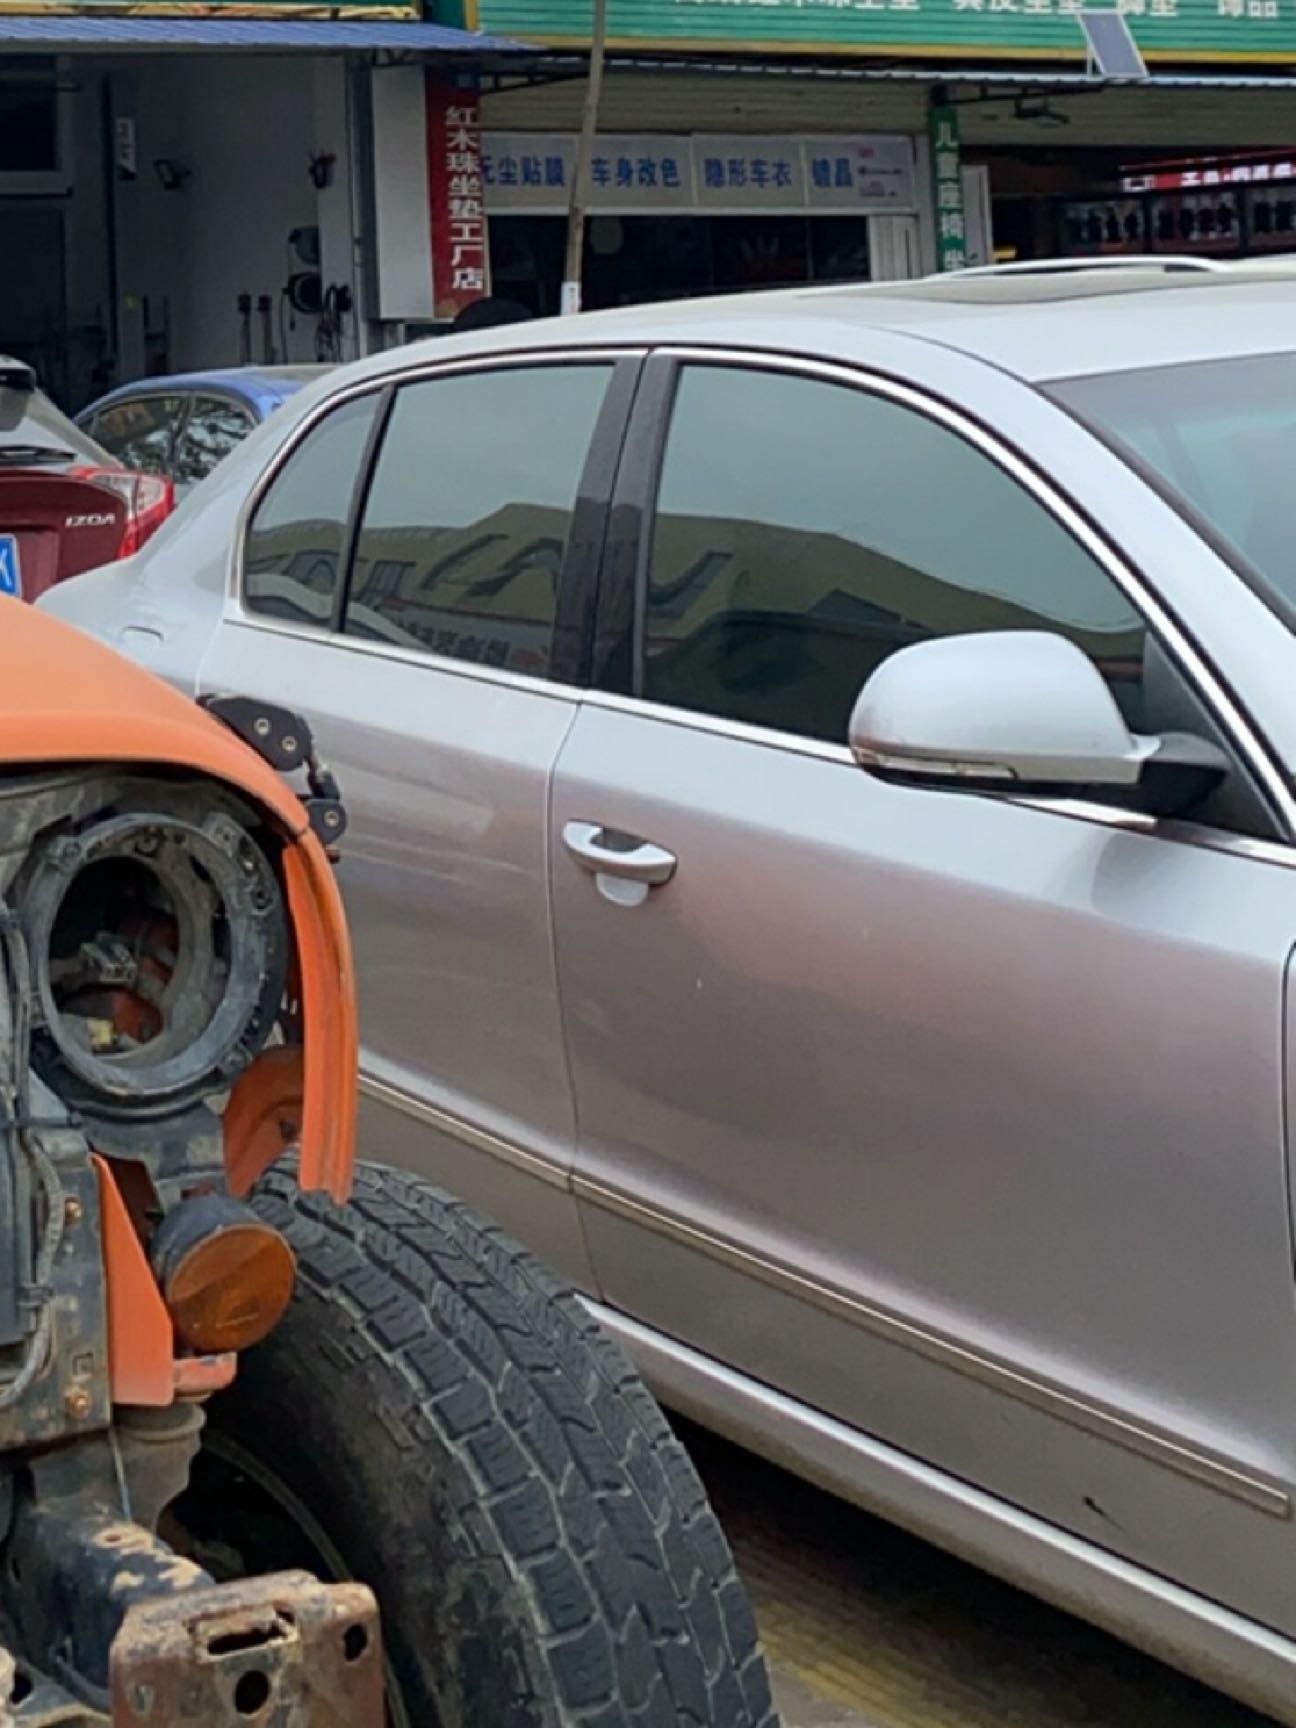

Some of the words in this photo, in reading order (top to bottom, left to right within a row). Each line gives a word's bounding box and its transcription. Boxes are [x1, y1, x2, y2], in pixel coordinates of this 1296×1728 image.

[444, 105, 485, 290] 红木珠坐垫工厂店
[591, 157, 681, 187] 车身改色
[705, 158, 792, 187] 隐形车衣
